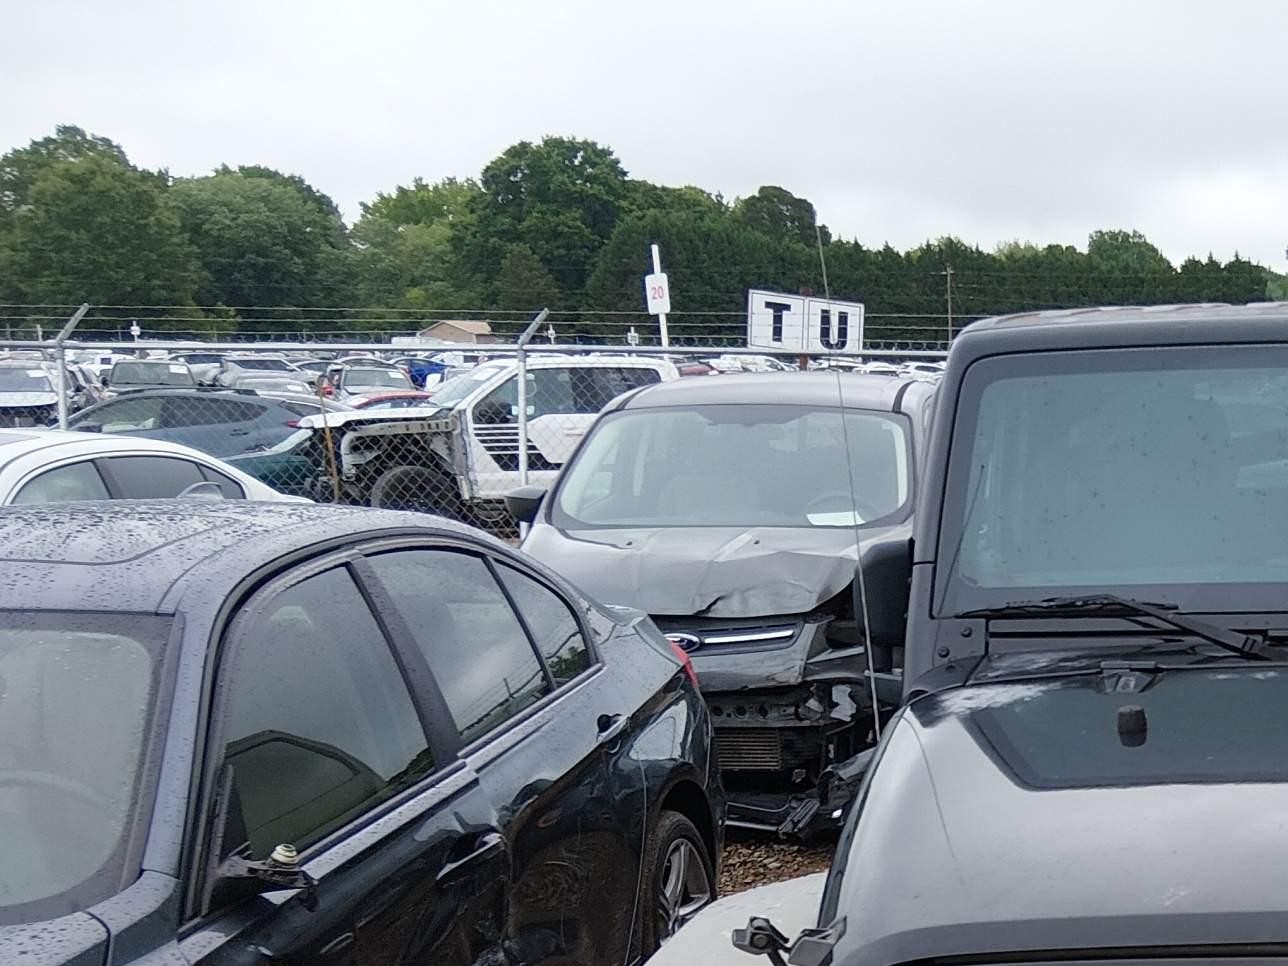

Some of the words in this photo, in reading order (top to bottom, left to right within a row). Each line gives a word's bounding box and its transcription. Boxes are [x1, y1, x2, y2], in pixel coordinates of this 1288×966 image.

[651, 286, 664, 300] 20
[764, 301, 792, 343] T
[819, 309, 849, 351] U
